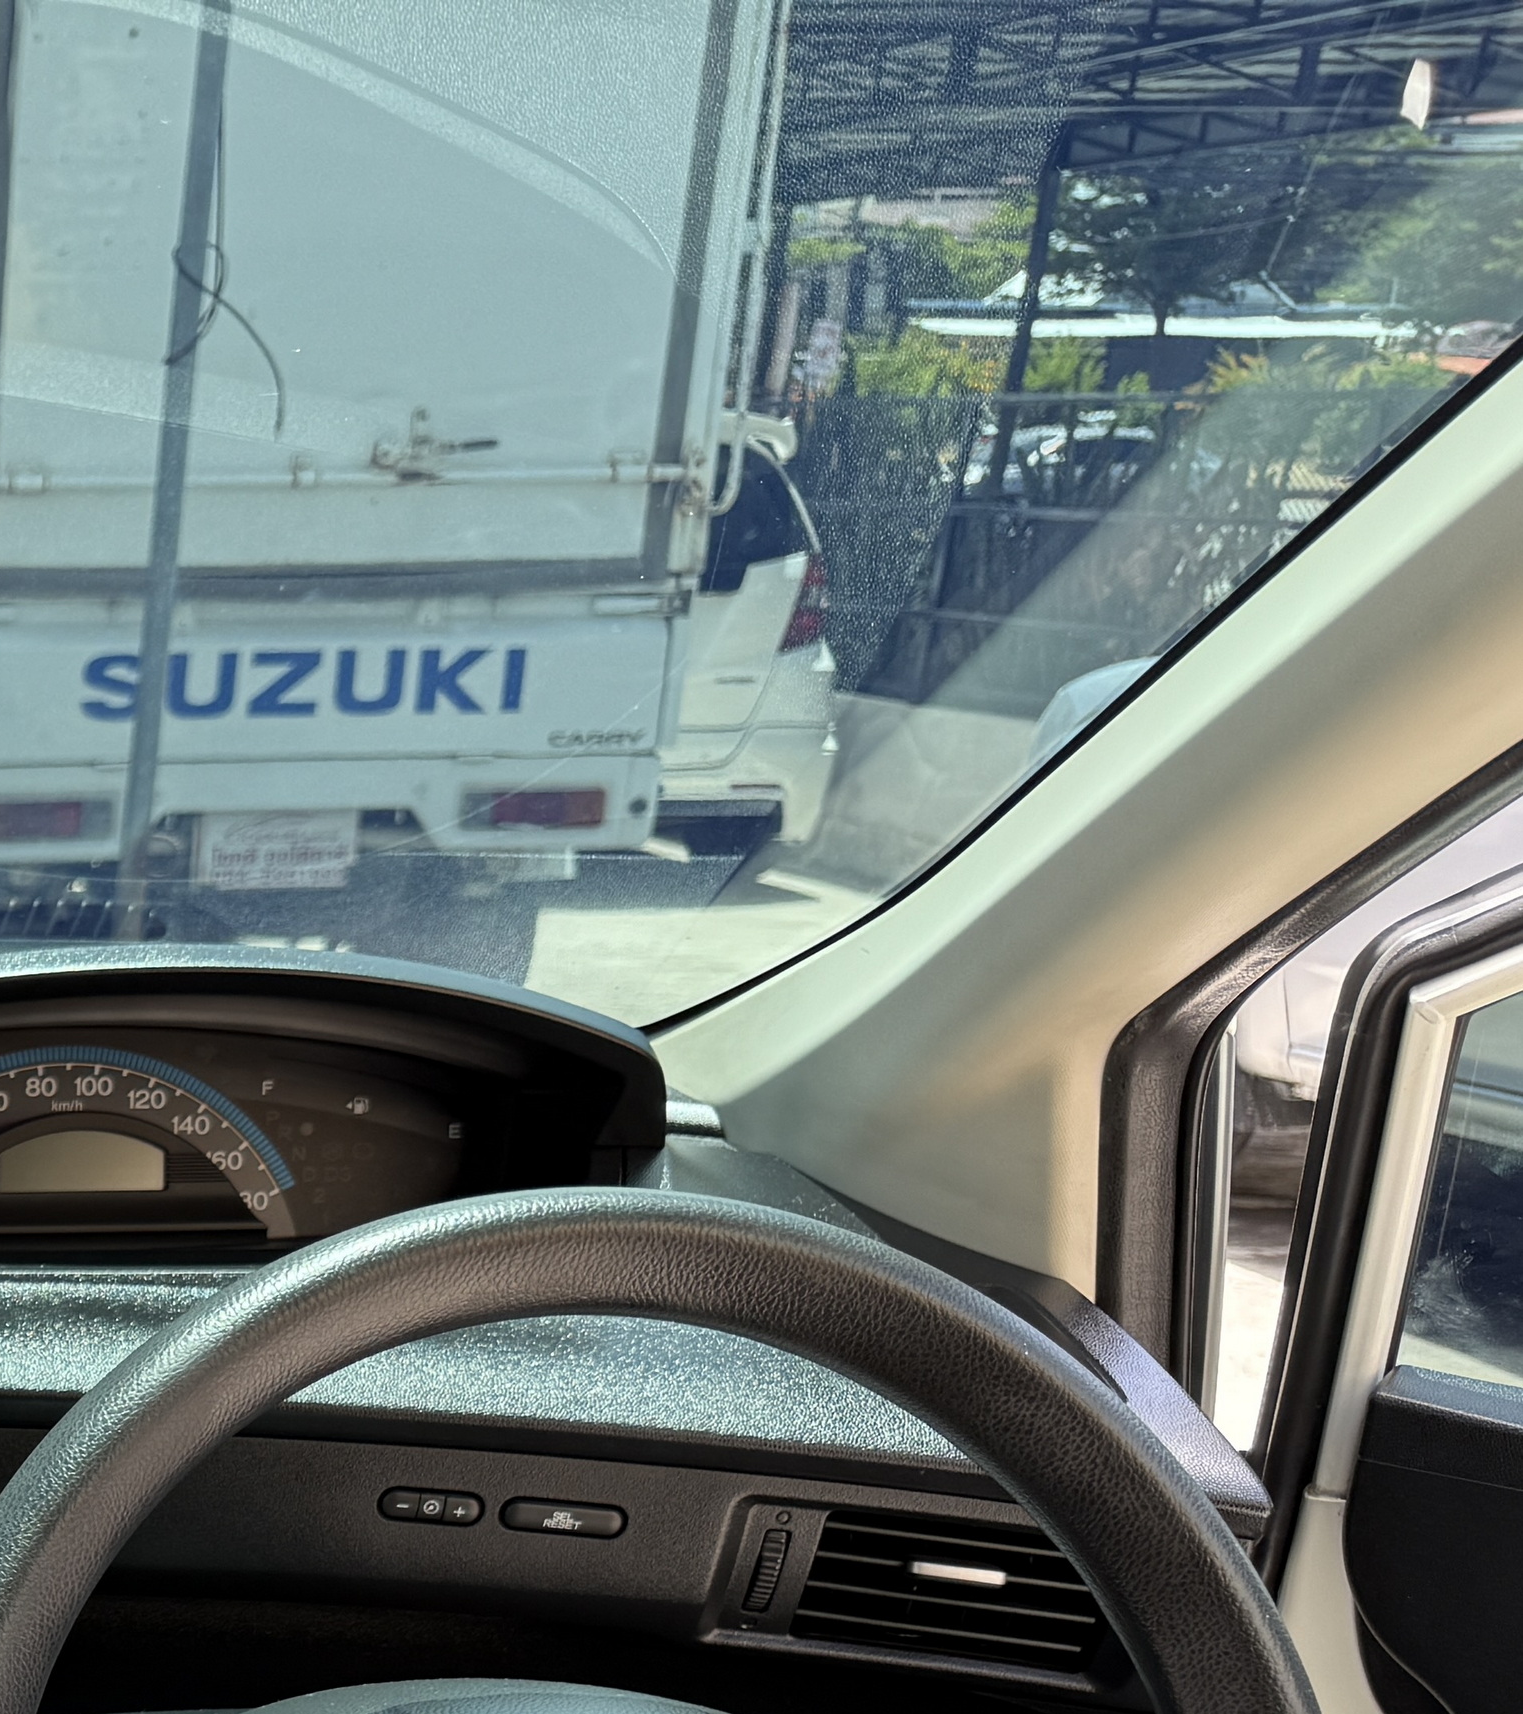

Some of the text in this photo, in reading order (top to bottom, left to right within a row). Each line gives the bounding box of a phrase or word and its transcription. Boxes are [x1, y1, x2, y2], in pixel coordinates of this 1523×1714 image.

[80, 645, 527, 722] SUZUKI
[26, 1077, 56, 1097] 80
[74, 1077, 113, 1097] 100
[262, 1080, 274, 1095] F
[51, 1100, 83, 1112] km/h
[127, 1090, 166, 1110] 120
[172, 1116, 210, 1135] 140
[449, 1124, 462, 1138] E
[543, 1518, 582, 1530] RESET
